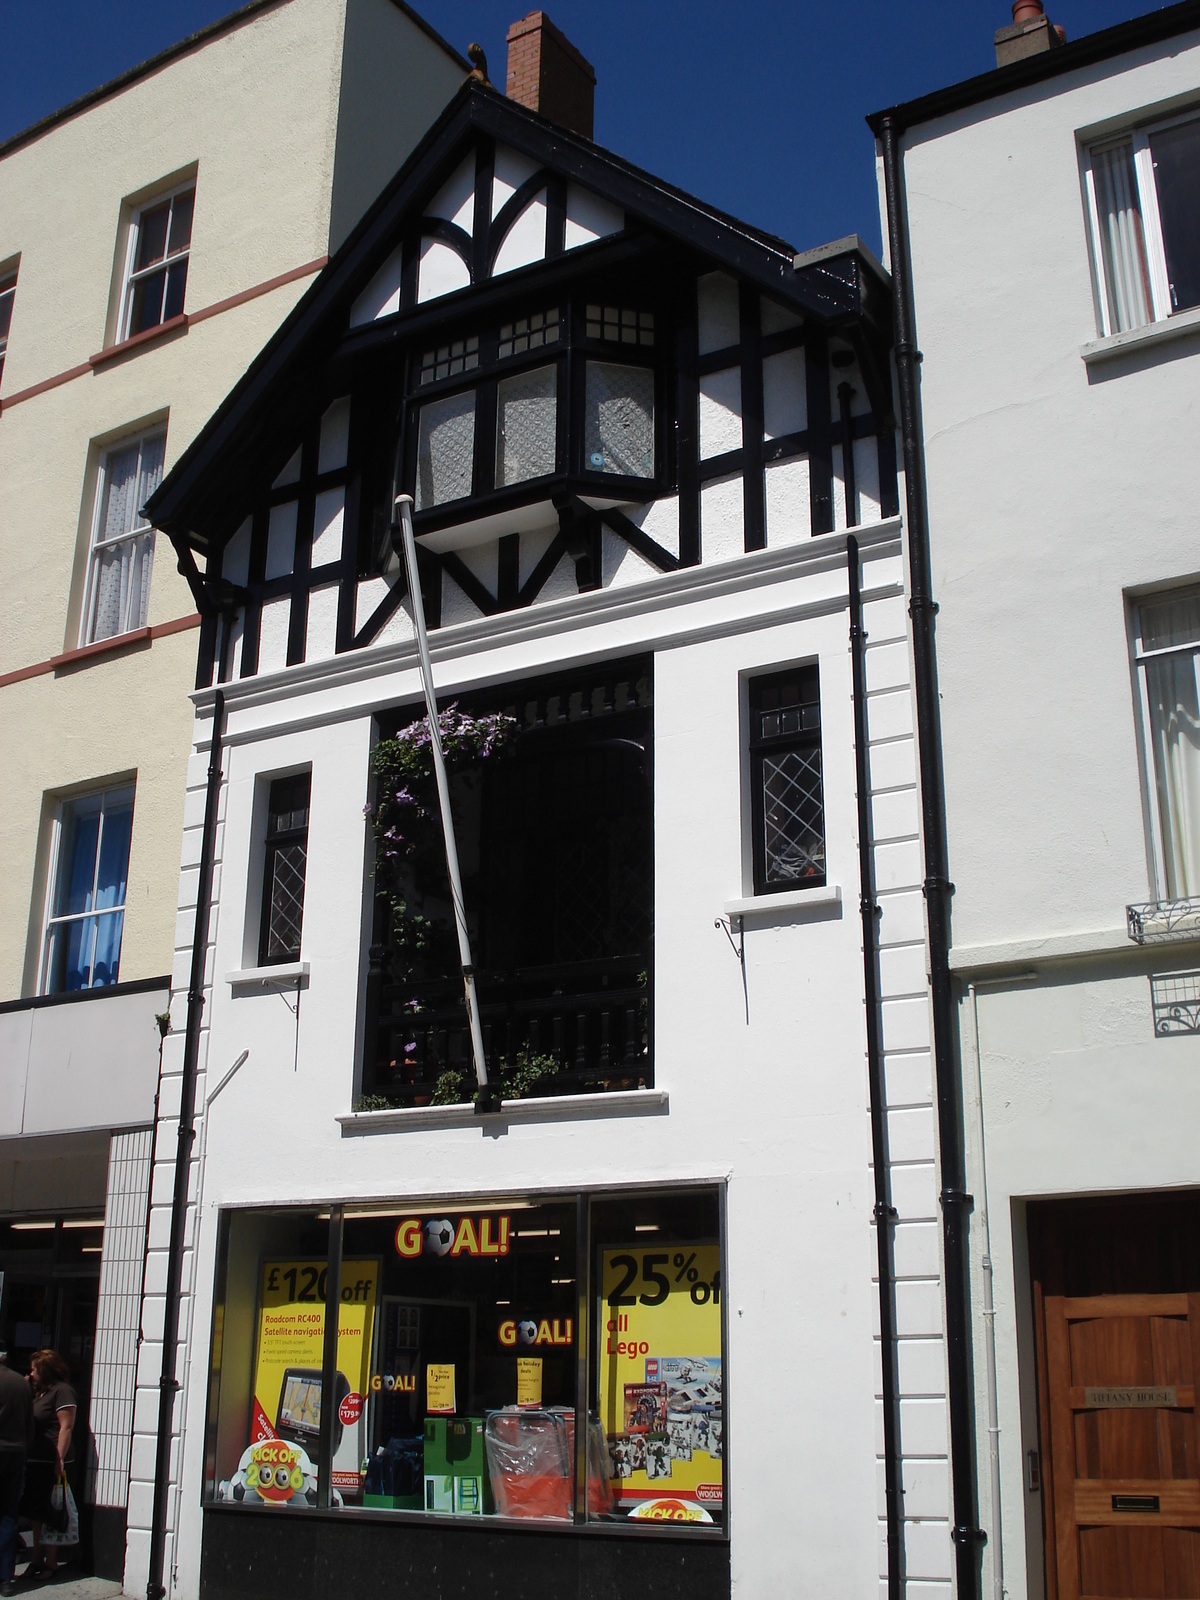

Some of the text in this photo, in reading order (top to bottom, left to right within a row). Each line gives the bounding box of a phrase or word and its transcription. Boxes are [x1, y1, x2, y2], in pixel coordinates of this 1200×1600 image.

[341, 1280, 372, 1301] off
[690, 1270, 721, 1306] of
[265, 1314, 321, 1324] Roadcom RC400
[606, 1314, 628, 1332] all
[264, 1327, 361, 1338] Satellite navigati ystem
[606, 1337, 649, 1360] Lego
[1137, 1392, 1171, 1402] HOUSE
[257, 1413, 276, 1441] Satellit
[251, 1446, 302, 1464] KICK OFF
[246, 1462, 305, 1490] 2006
[638, 1507, 673, 1519] KICK
